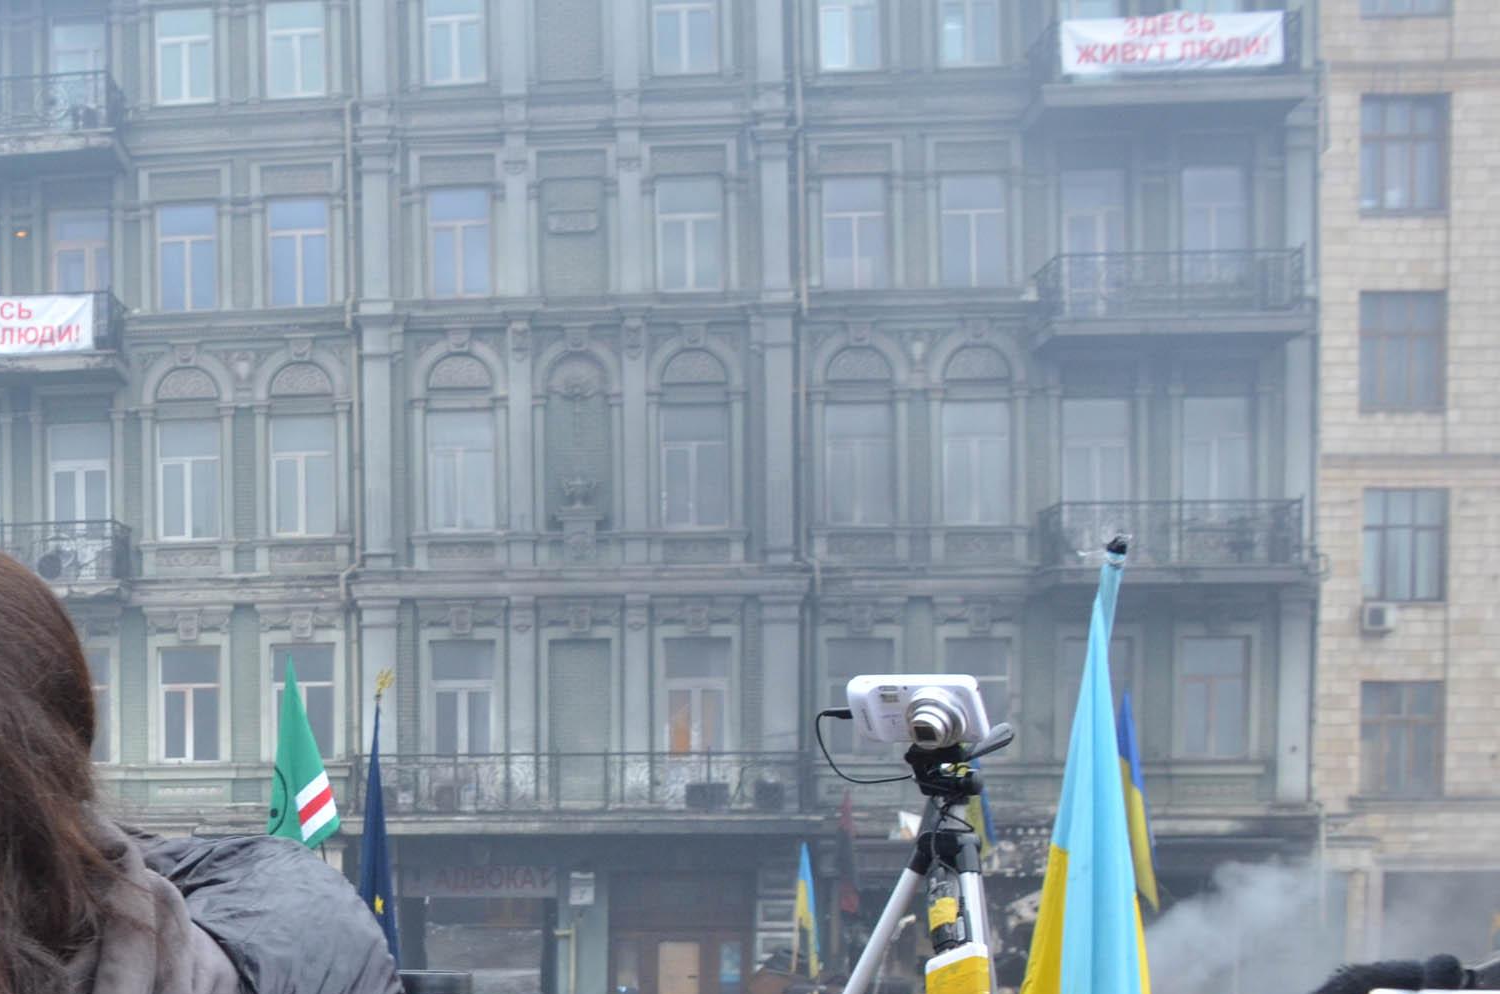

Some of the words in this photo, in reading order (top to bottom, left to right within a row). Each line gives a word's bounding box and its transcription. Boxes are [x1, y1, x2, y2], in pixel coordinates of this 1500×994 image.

[1123, 12, 1216, 37] ЗДЕСЬ
[1076, 41, 1168, 65] ЖИВУТ
[1179, 35, 1269, 61] ЛЮДИ!
[0, 324, 81, 346] ЛЮДИ!
